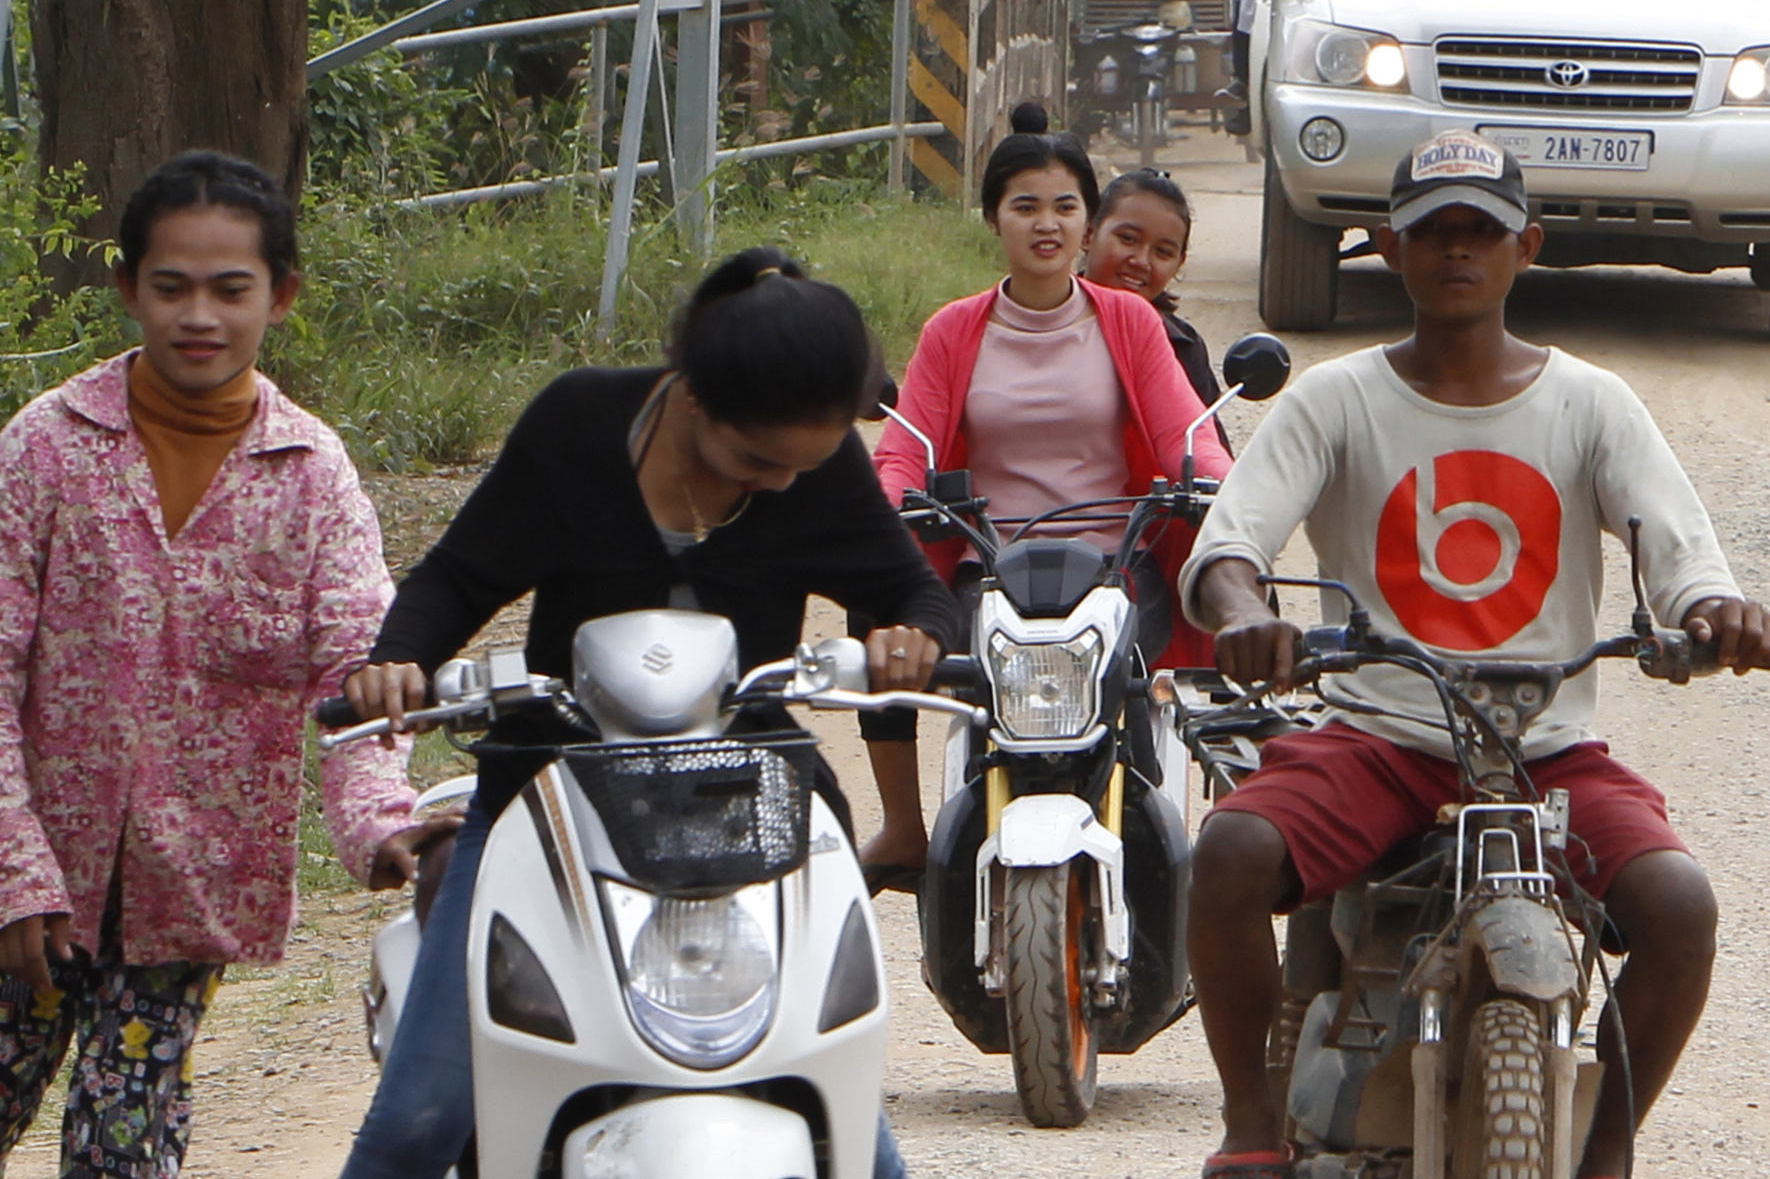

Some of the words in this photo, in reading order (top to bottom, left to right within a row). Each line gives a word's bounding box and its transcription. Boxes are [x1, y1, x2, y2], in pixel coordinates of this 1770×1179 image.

[1418, 144, 1459, 171] HOLY
[1465, 146, 1498, 166] DAY
[1544, 136, 1641, 163] 2AN-7807
